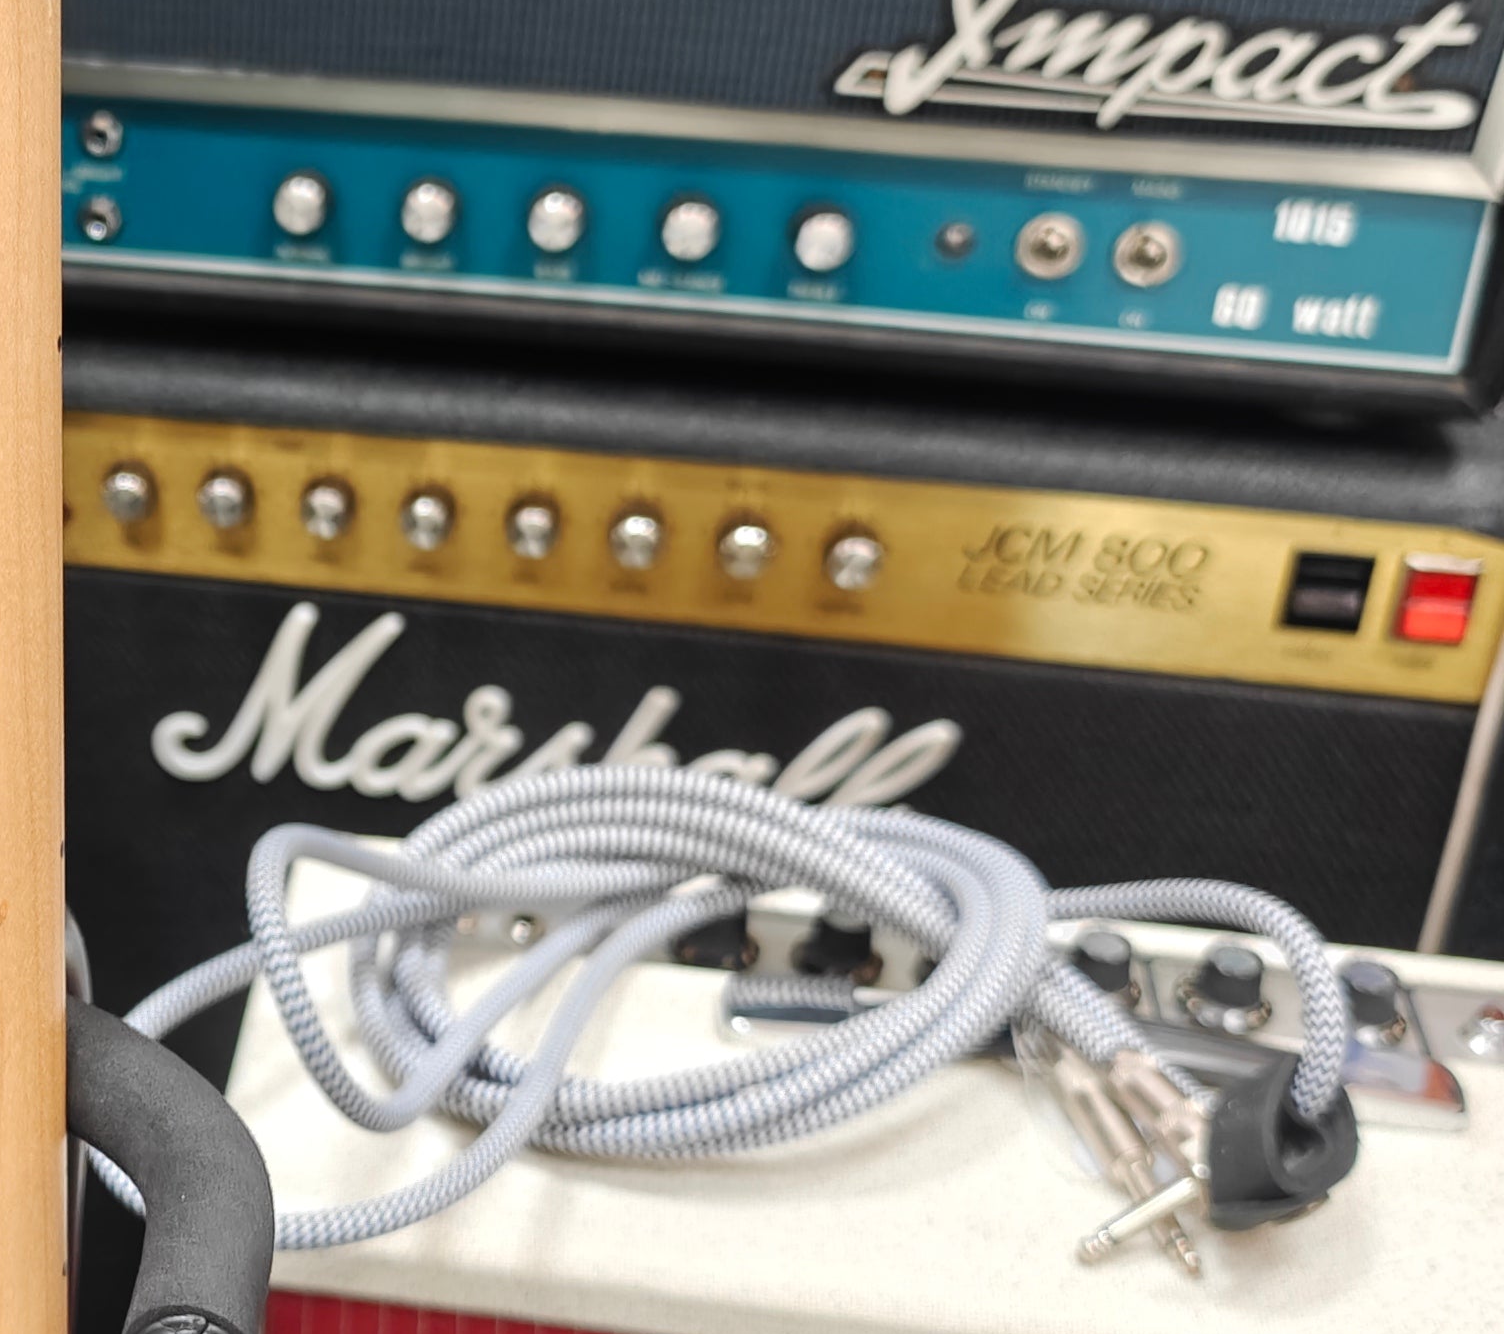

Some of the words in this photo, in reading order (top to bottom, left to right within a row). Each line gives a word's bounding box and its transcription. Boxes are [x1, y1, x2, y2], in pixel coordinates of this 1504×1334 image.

[1292, 293, 1380, 340] watt
[960, 524, 1082, 565] JCM
[1094, 533, 1209, 579] 800
[957, 563, 1064, 597] LEAD
[1073, 571, 1203, 614] SERIES
